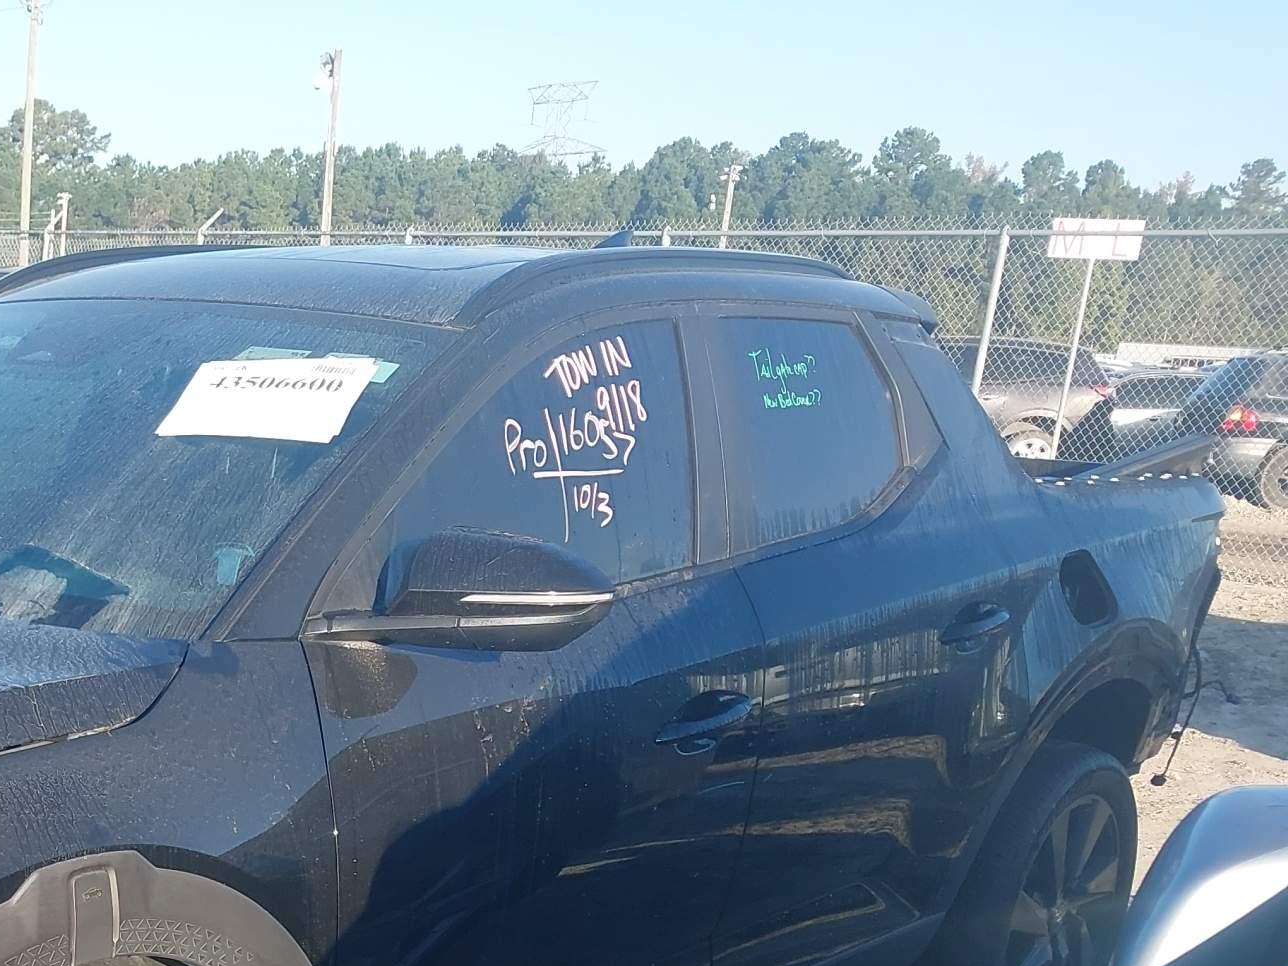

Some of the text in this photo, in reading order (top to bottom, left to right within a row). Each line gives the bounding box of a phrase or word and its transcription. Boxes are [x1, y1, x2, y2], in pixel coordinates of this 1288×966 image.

[210, 376, 344, 392] 43506600
[543, 336, 632, 398] TOW IN
[574, 482, 613, 528] 10/3
